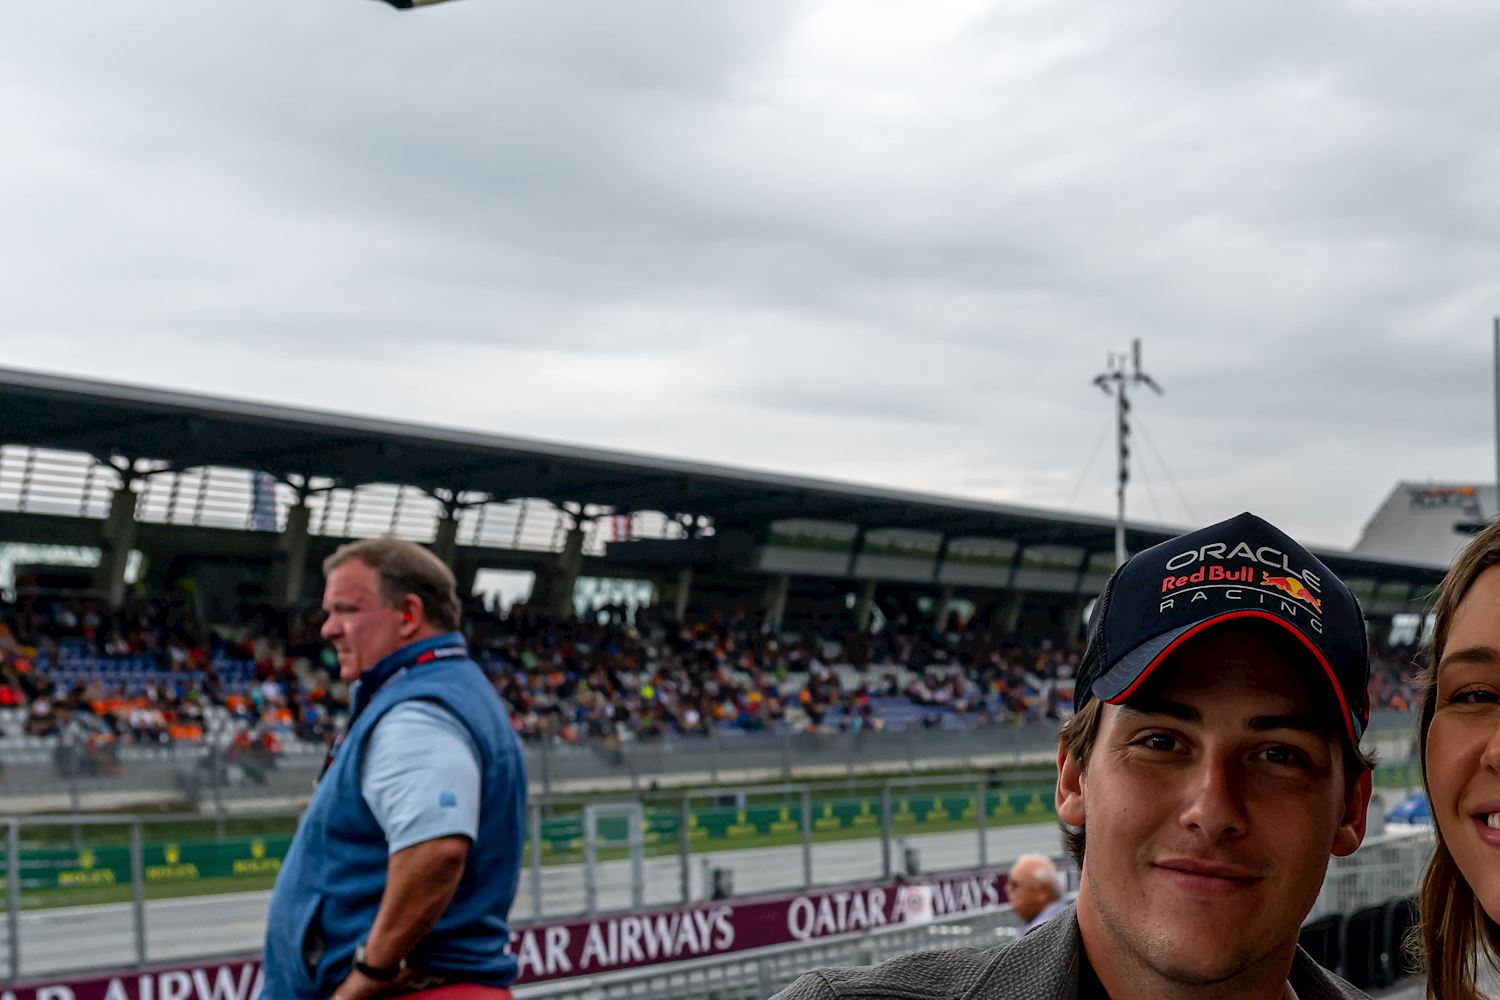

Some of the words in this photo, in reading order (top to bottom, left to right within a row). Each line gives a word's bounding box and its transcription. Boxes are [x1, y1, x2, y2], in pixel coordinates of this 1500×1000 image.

[1161, 565, 1205, 593] Red
[1208, 565, 1254, 583] Bull
[1165, 541, 1322, 594] ORACLE
[1159, 589, 1323, 635] RACING
[578, 904, 736, 970] AIRWAYS
[787, 885, 888, 941] QATAR
